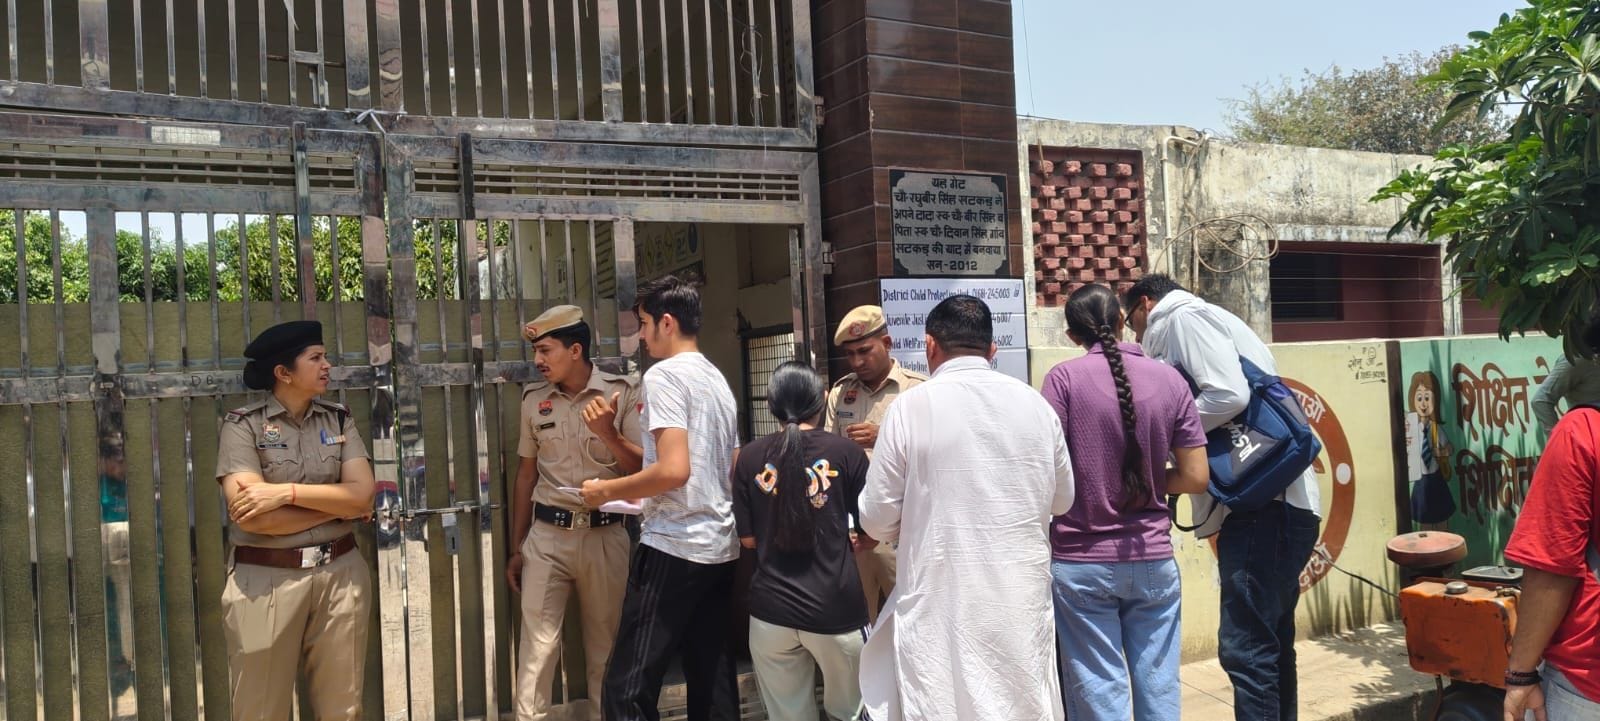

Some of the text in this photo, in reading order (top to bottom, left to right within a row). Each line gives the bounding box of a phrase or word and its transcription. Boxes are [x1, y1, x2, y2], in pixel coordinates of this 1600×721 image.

[931, 175, 966, 190] यह गेट
[938, 190, 957, 206] सिंह
[995, 193, 1003, 207] ने
[894, 206, 914, 220] अपने
[915, 209, 935, 222] दादा
[979, 209, 996, 223] सिंह
[997, 213, 1004, 222] व
[894, 223, 912, 237] पिता
[931, 241, 944, 254] की
[945, 244, 962, 256] याद
[963, 241, 972, 255] में
[883, 288, 908, 301] District
[910, 288, 926, 300] Child
[886, 313, 911, 326] Juvenile
